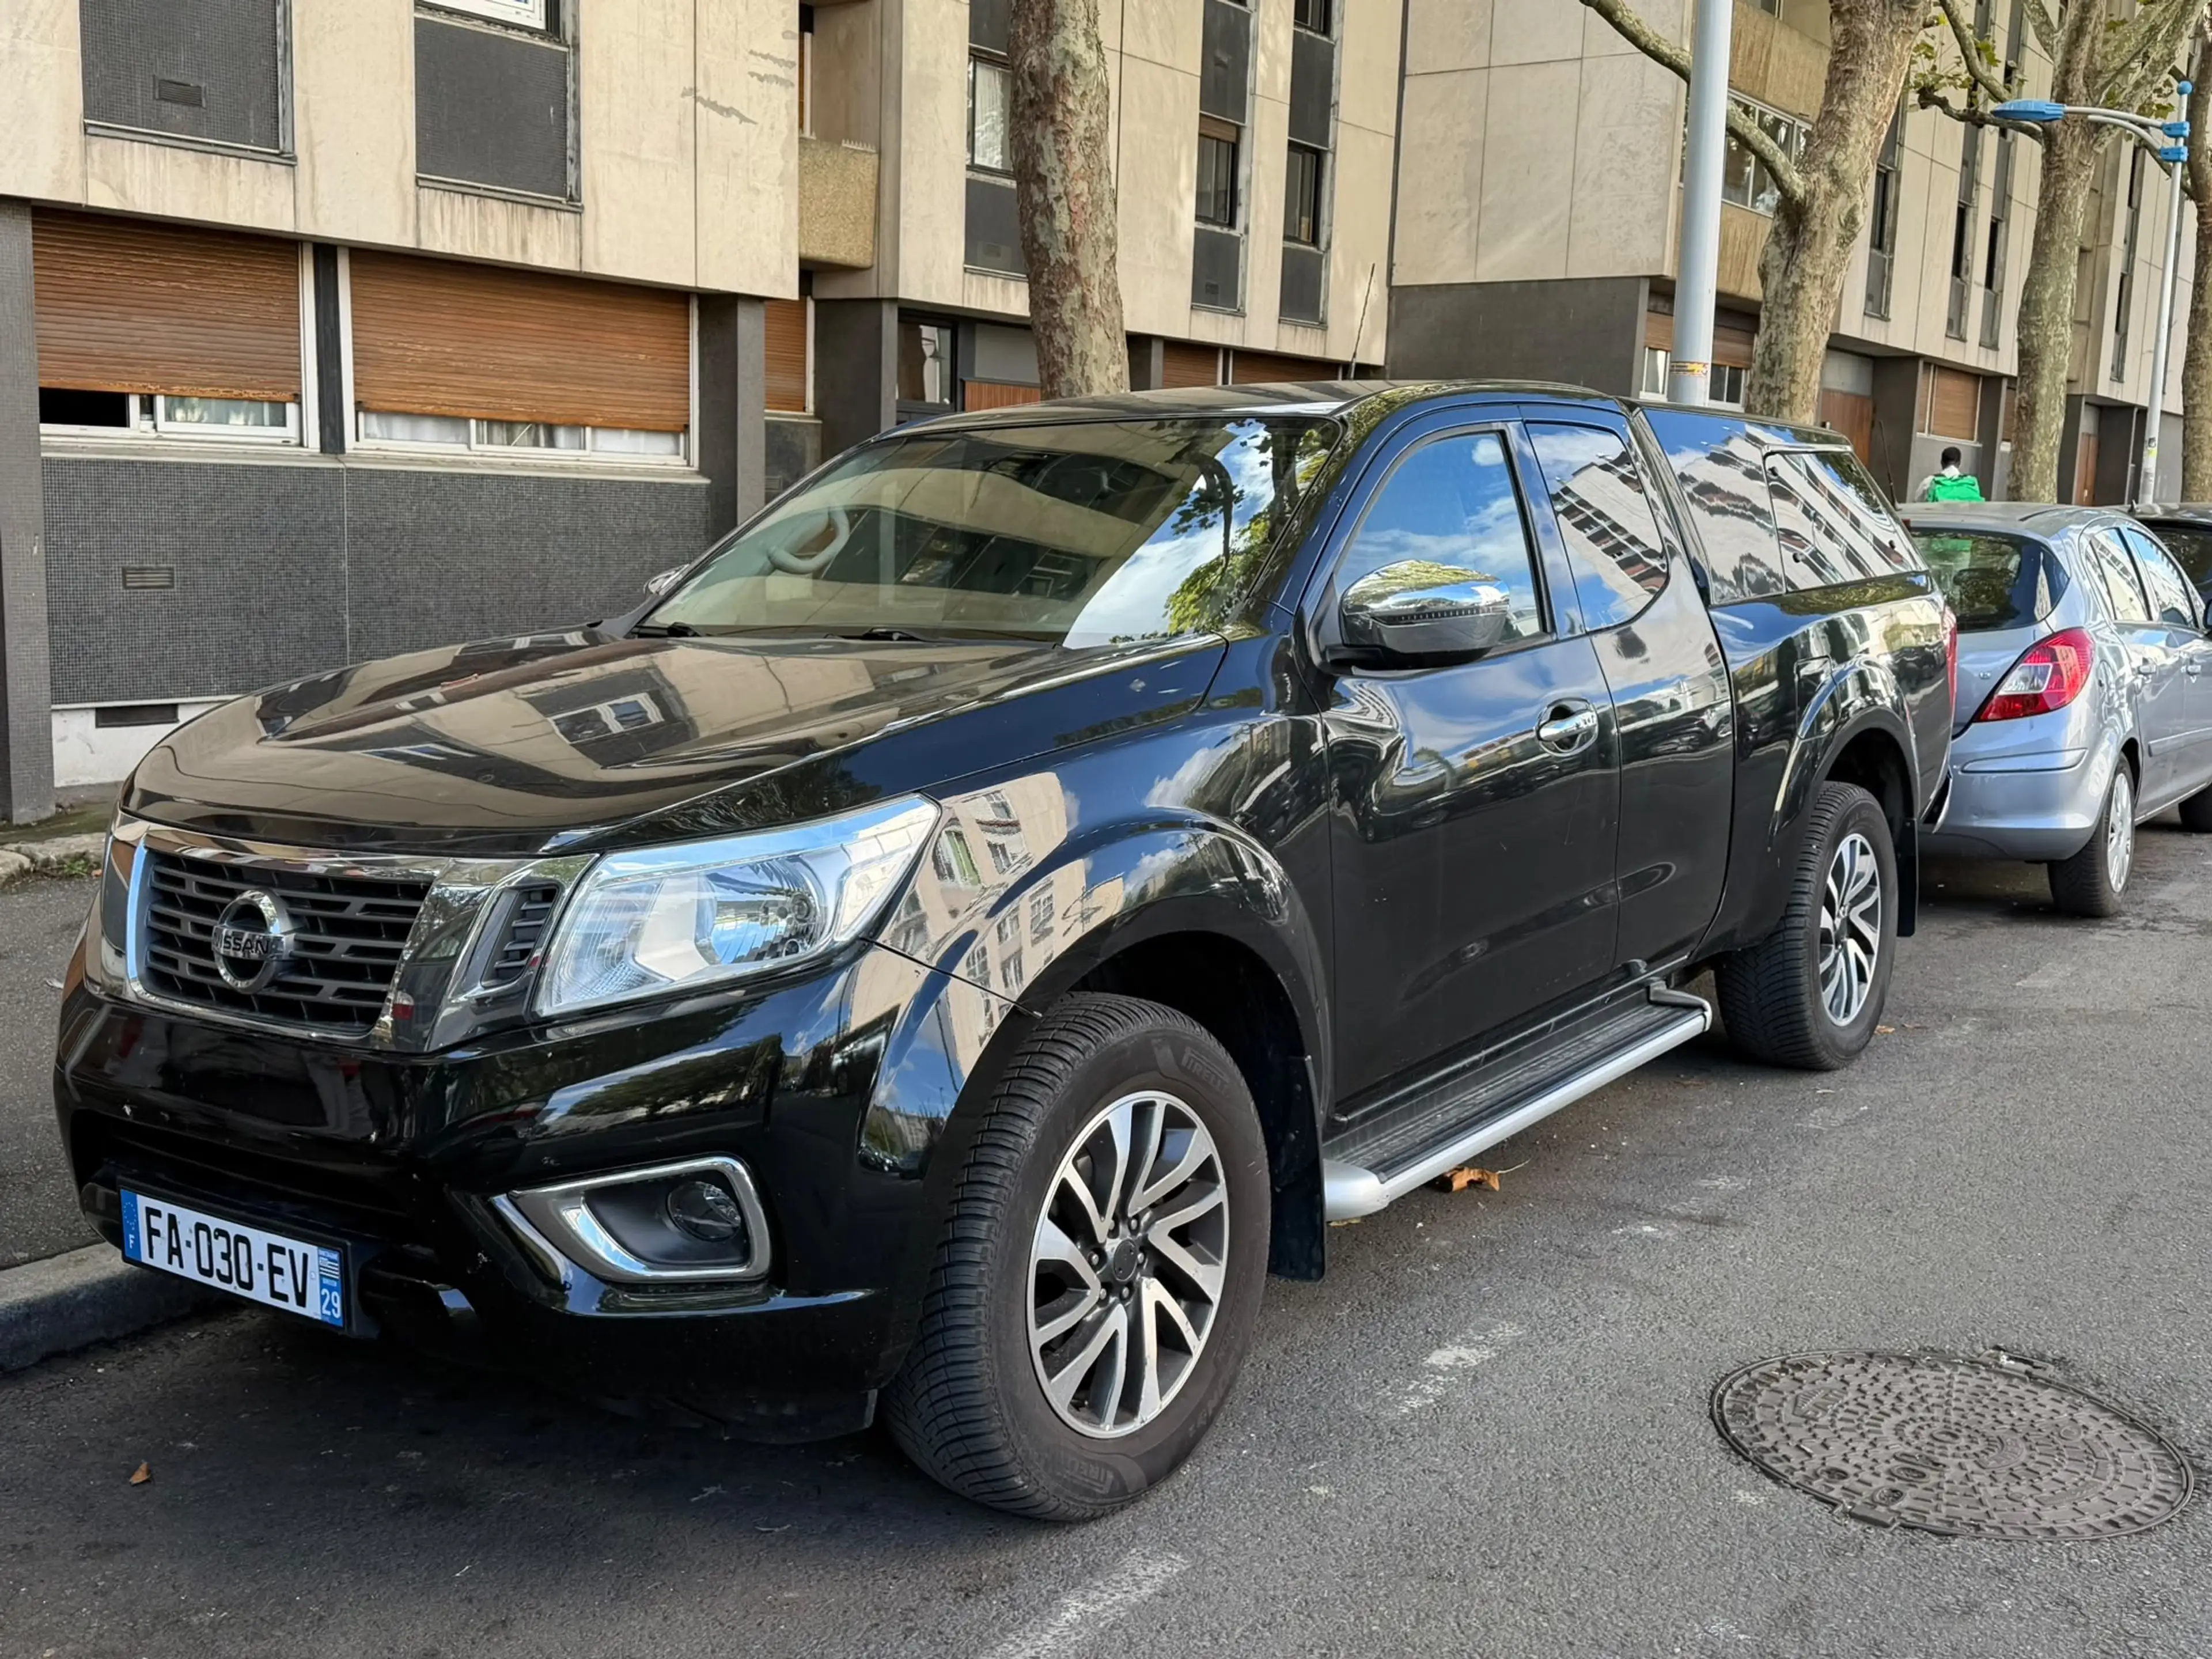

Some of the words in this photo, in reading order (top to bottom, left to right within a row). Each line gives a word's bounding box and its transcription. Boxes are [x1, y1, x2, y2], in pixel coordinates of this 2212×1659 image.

[129, 1234, 135, 1249] F
[145, 1206, 308, 1308] FA-030-EV
[321, 1289, 341, 1318] 29
